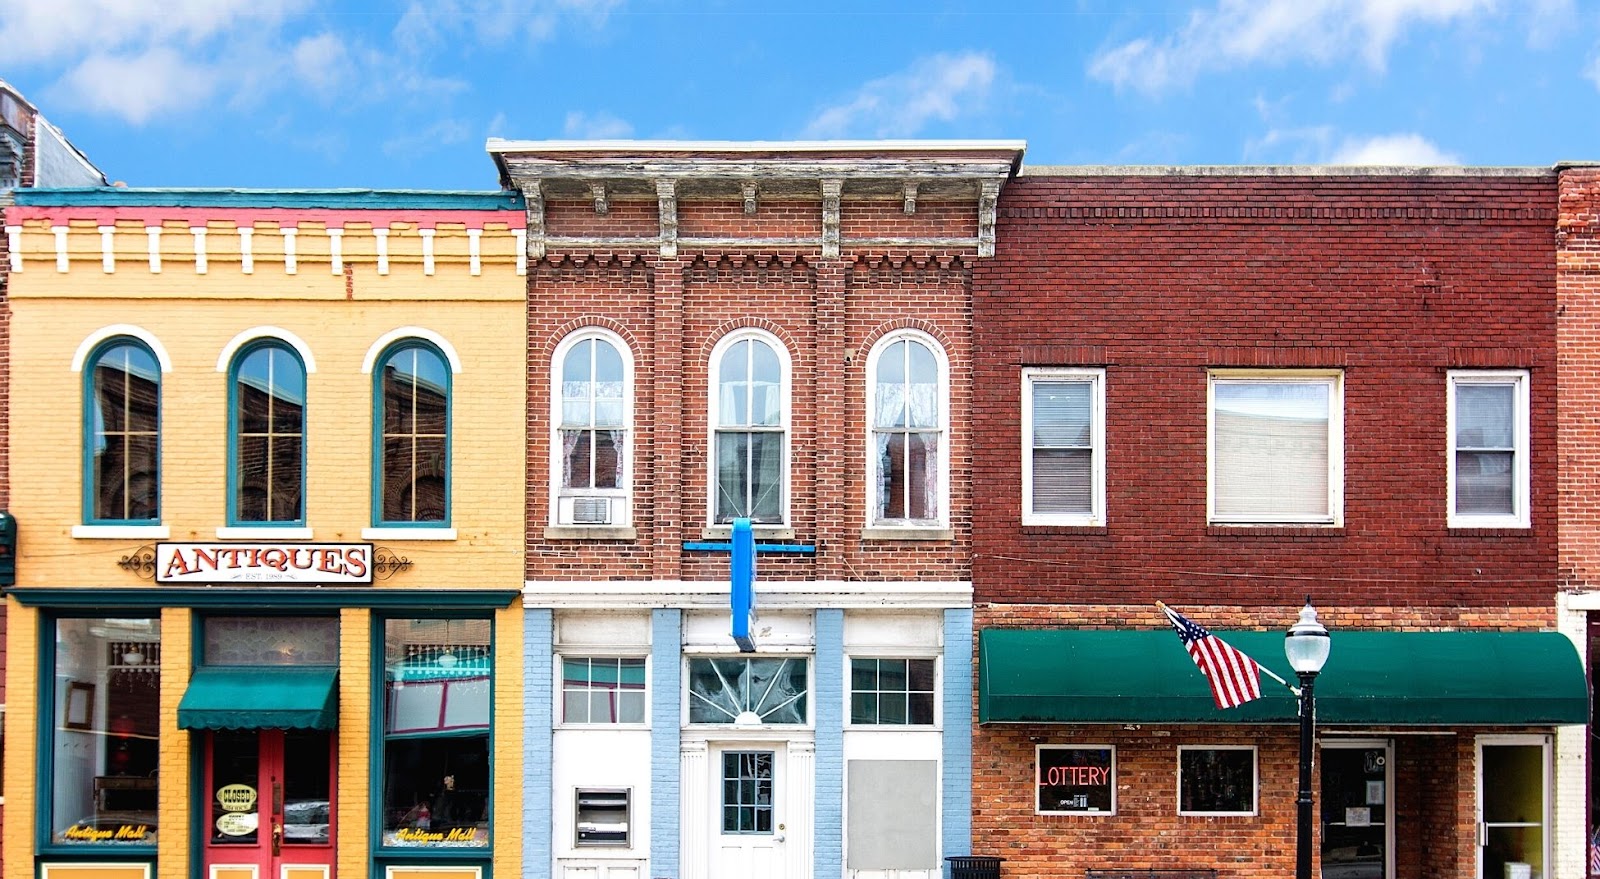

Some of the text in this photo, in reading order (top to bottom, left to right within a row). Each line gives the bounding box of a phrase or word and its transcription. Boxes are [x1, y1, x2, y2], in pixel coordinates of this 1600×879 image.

[163, 548, 367, 577] ANTIQUES
[1038, 766, 1110, 786] LOTTERY
[223, 789, 250, 803] CLOSED
[64, 824, 146, 841] Antique Mall
[396, 828, 477, 845] Antique Mall
